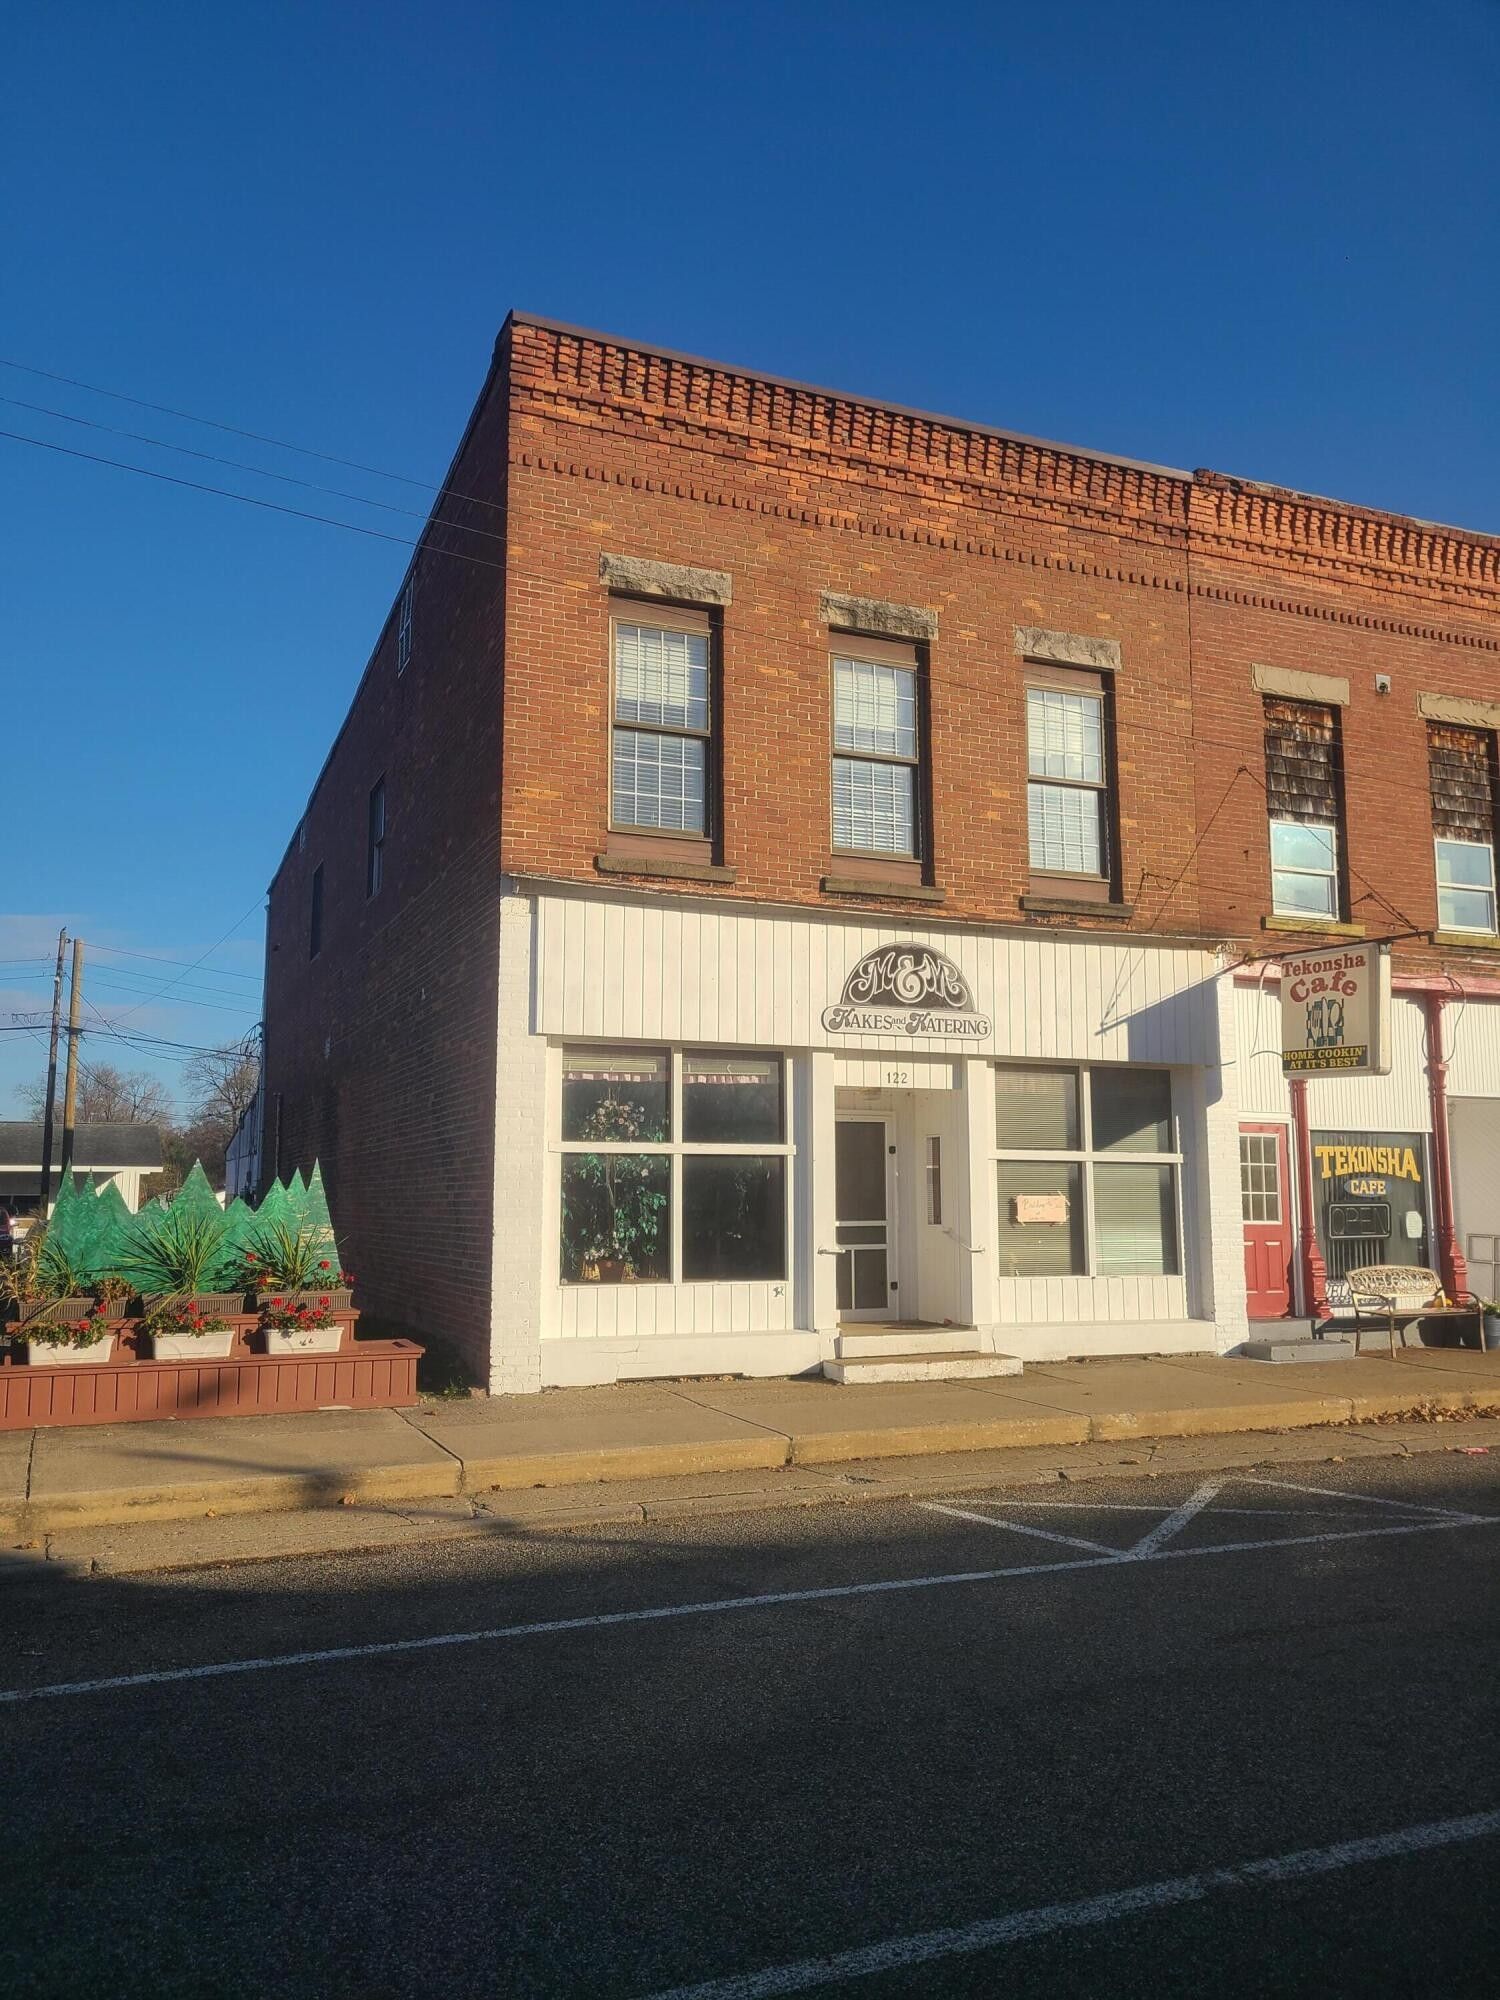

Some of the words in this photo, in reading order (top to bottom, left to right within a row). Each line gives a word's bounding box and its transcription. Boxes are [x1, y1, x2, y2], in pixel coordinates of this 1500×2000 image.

[1281, 953, 1367, 978] Tekonsha
[1290, 970, 1358, 1003] Cafe
[828, 1007, 893, 1031] KAKES
[892, 1016, 906, 1026] and
[905, 1012, 989, 1036] KATERING
[1283, 1050, 1315, 1061] HOME
[1317, 1046, 1366, 1059] COOKIN'
[1289, 1060, 1304, 1070] AT
[1305, 1058, 1327, 1069] IT'S
[1329, 1056, 1359, 1067] BEST
[887, 1071, 908, 1084] 122
[1314, 1145, 1421, 1182] TEKONSHA
[1350, 1180, 1386, 1195] CAFE
[1331, 1207, 1388, 1236] OPEN
